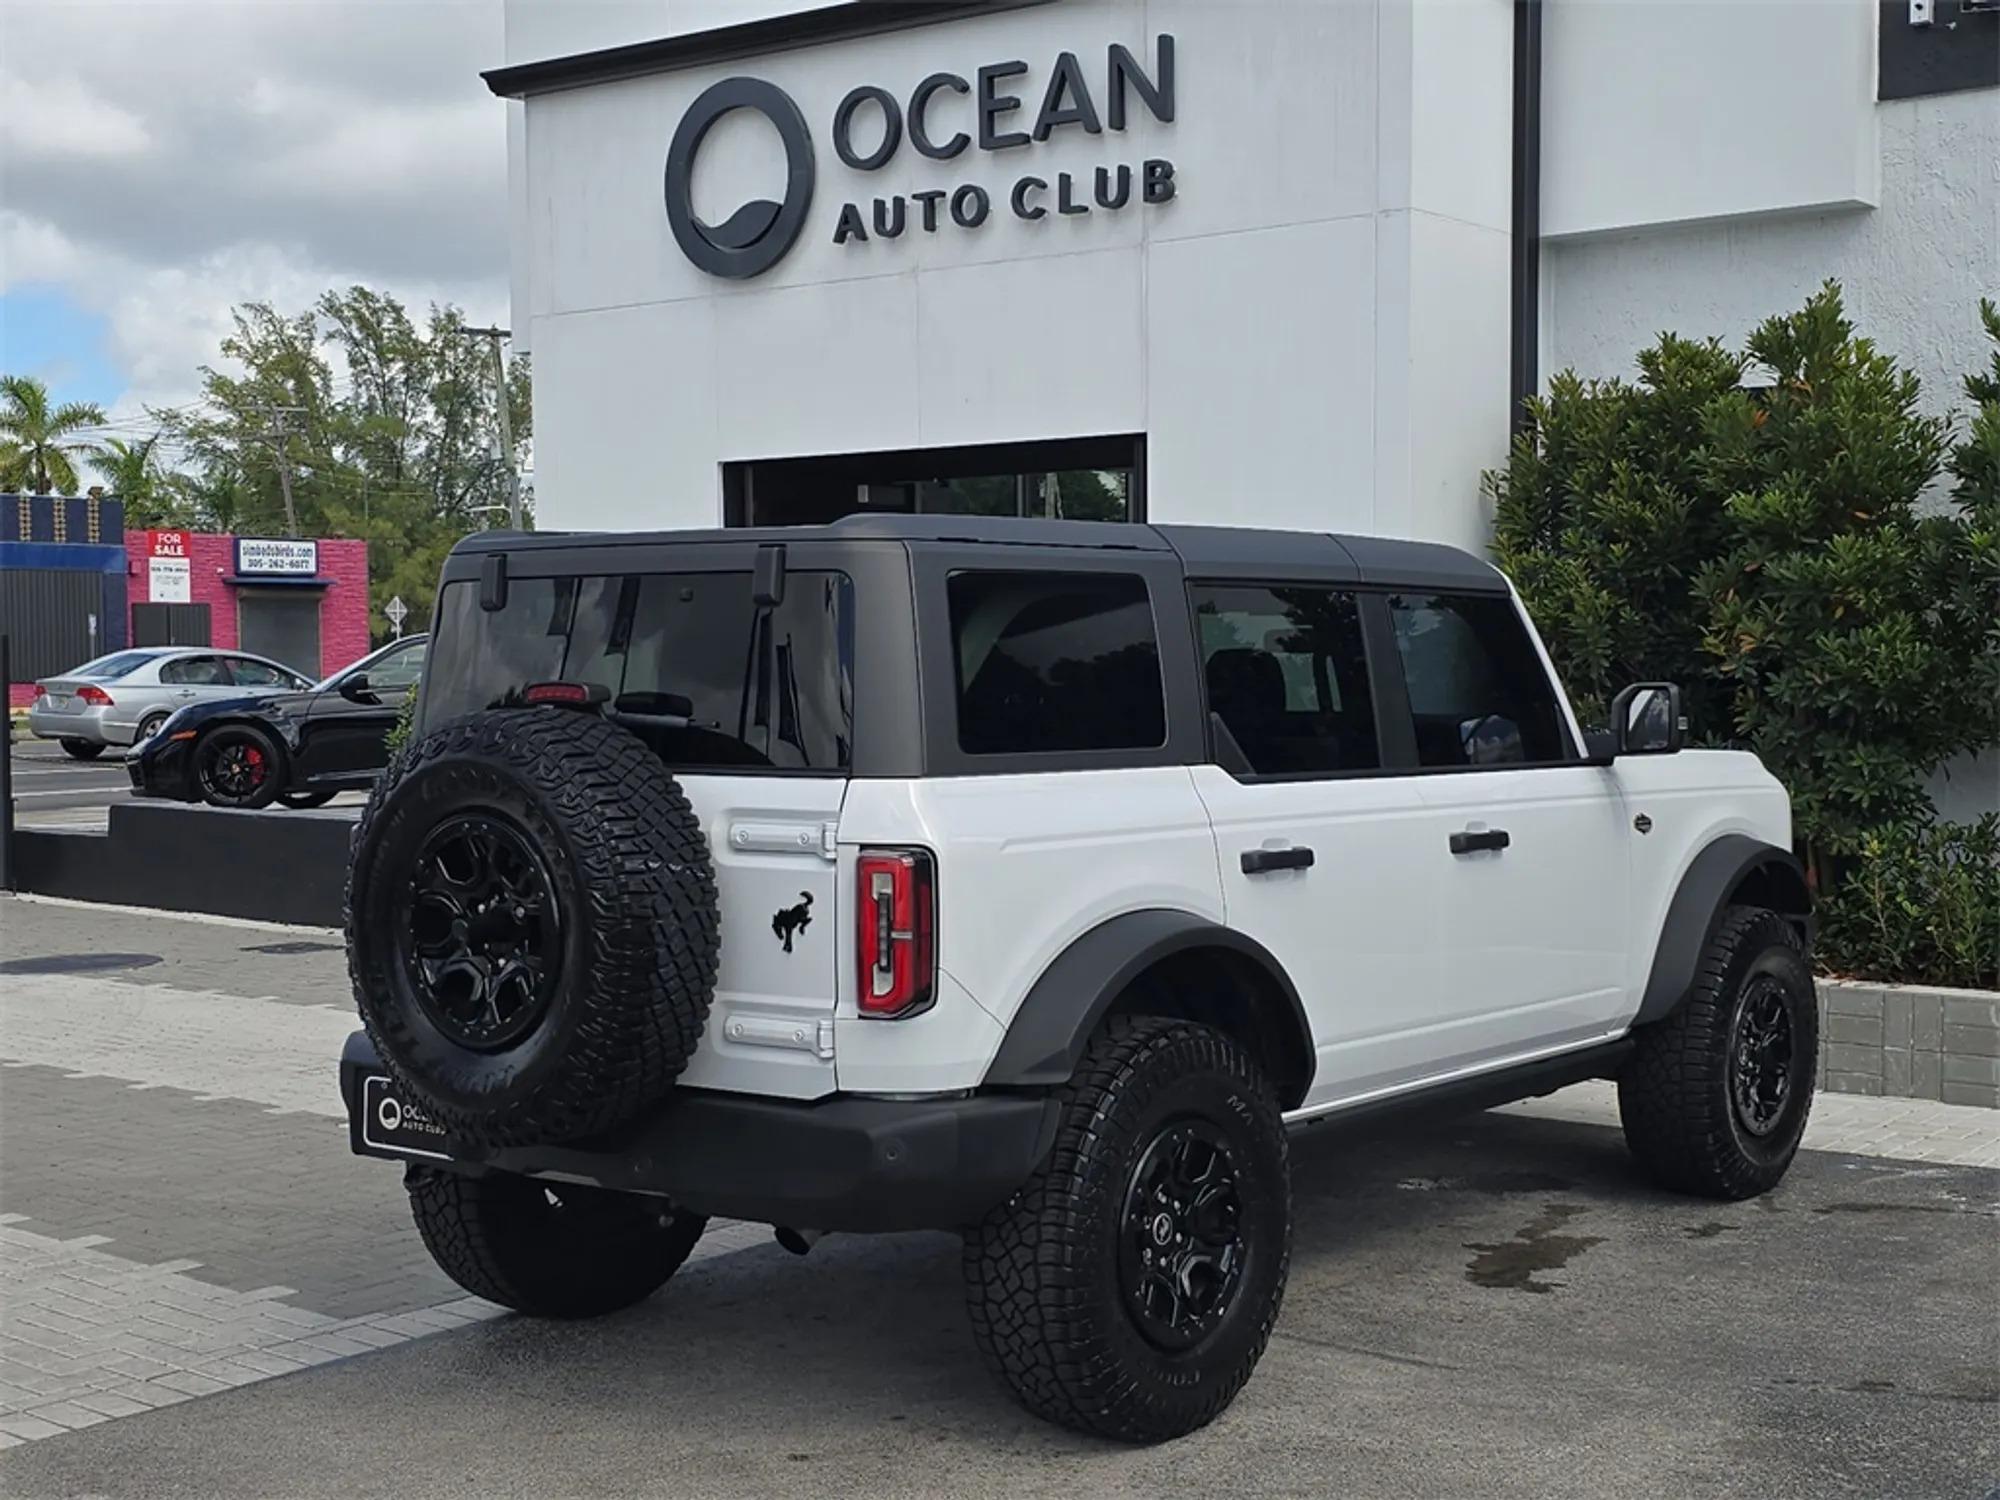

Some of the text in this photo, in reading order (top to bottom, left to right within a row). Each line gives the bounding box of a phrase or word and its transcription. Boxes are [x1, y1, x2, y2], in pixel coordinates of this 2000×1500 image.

[833, 34, 1175, 171] OCEAN
[833, 159, 1176, 244] AUTO CLUB
[154, 544, 184, 556] SALE
[157, 533, 181, 544] FOR
